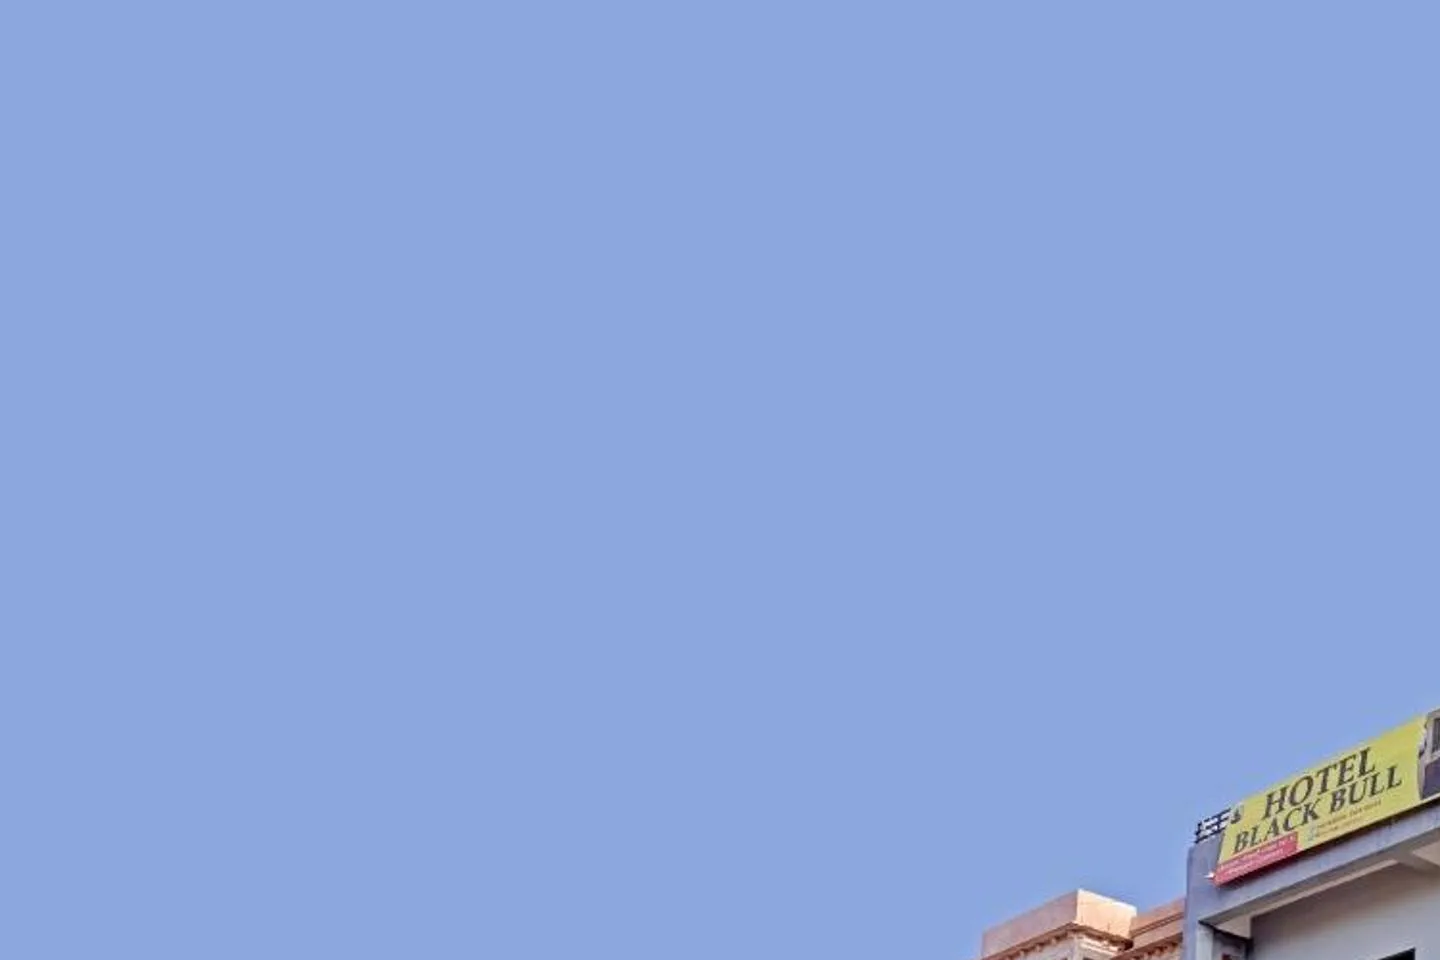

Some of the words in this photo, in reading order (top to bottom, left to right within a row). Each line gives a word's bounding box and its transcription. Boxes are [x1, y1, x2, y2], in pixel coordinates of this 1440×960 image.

[1234, 800, 1321, 854] BLACK
[1330, 766, 1402, 814] BULL
[1262, 747, 1376, 819] HOTEL
